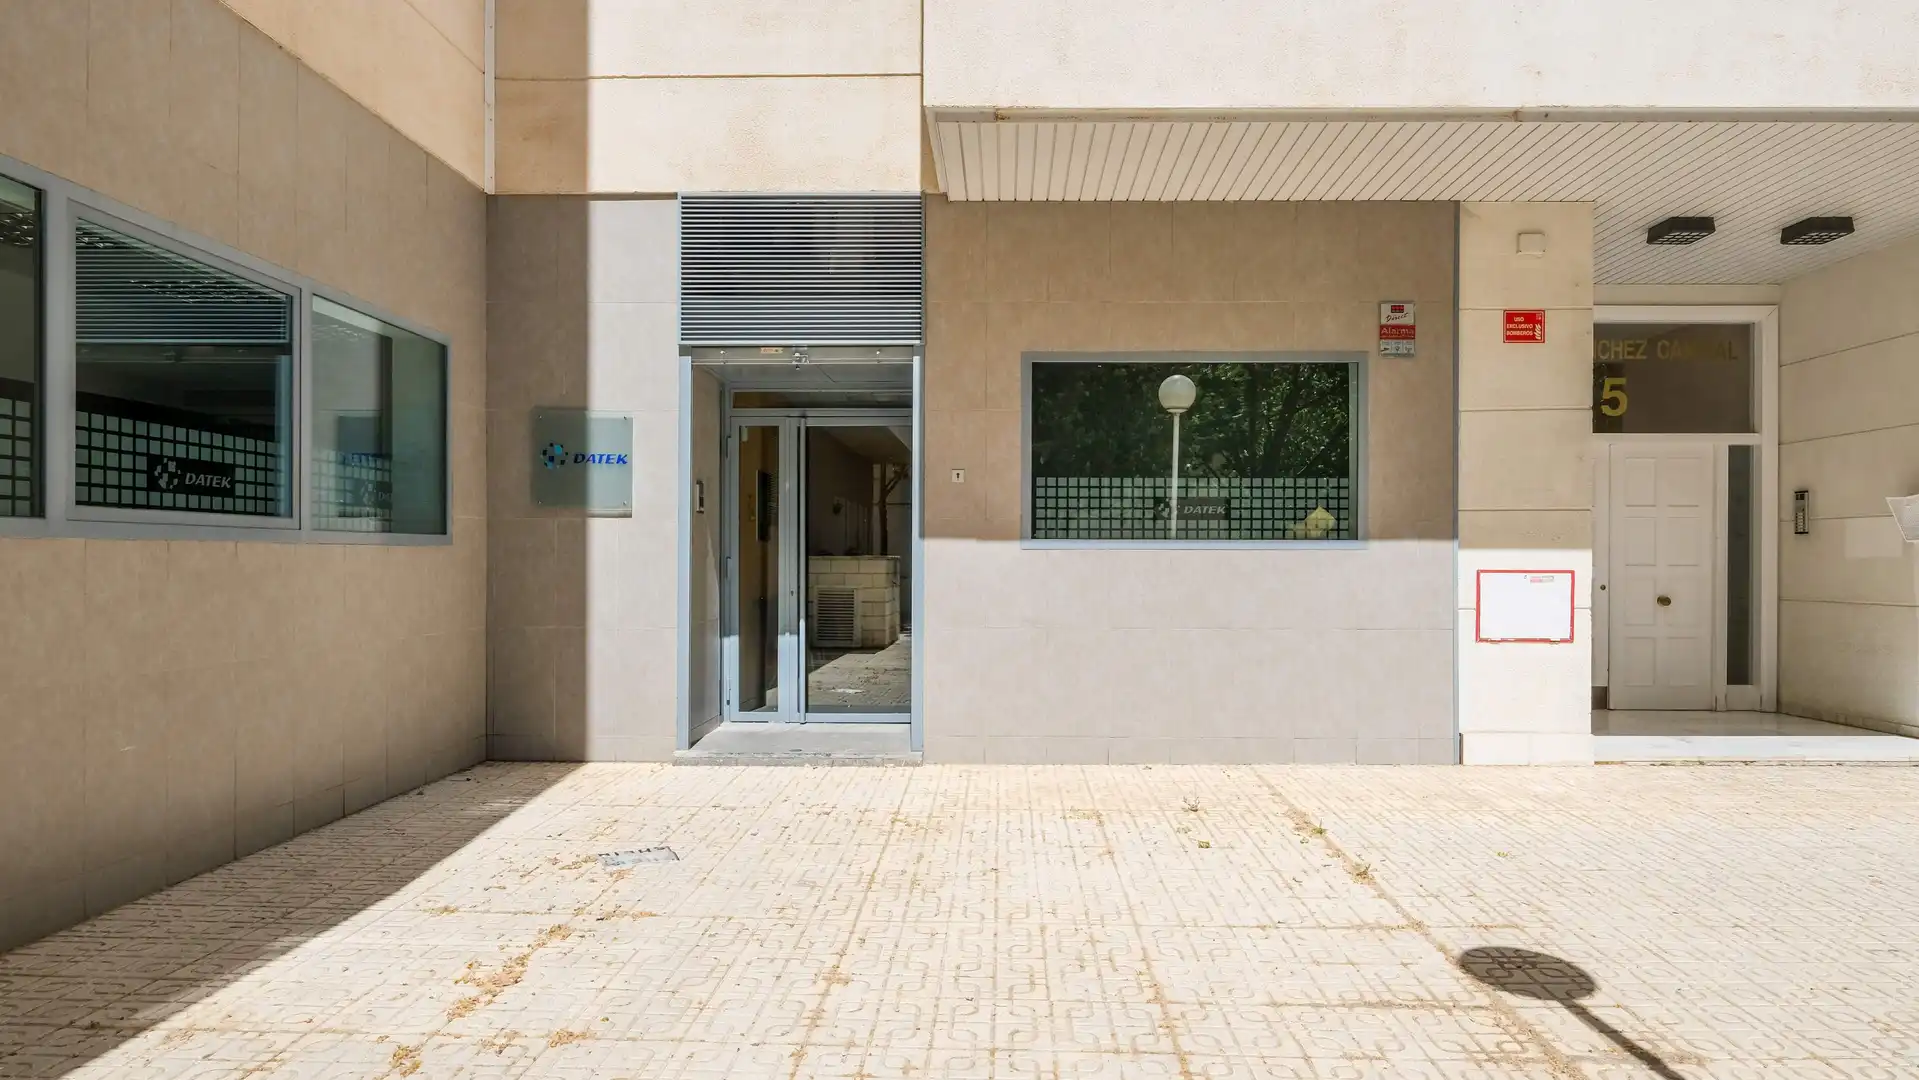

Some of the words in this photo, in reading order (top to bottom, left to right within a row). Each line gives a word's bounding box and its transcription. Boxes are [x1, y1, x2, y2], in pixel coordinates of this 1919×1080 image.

[1594, 339, 1648, 360] CHEZ
[1601, 377, 1628, 417] 5
[573, 453, 628, 465] DATEK
[184, 472, 232, 488] DATEK
[1183, 505, 1226, 514] DATEK
